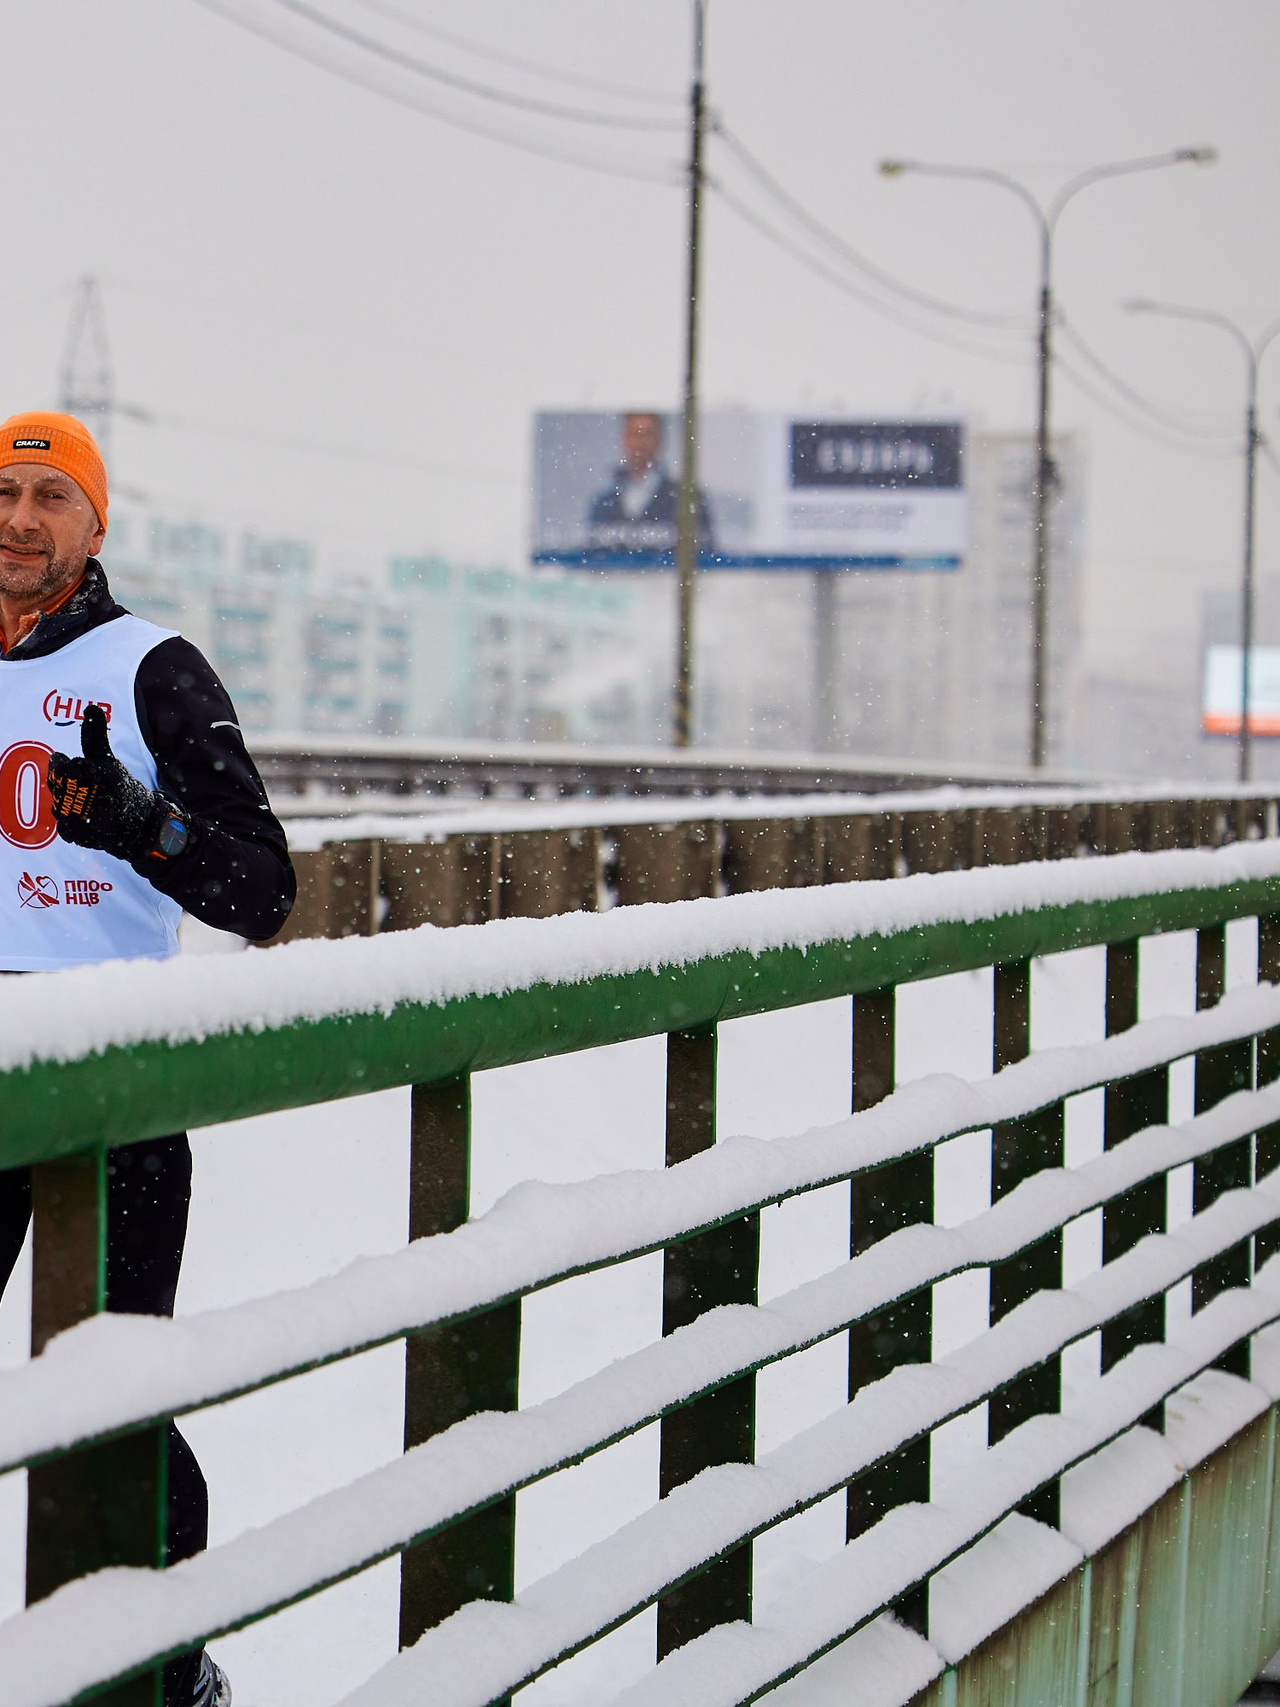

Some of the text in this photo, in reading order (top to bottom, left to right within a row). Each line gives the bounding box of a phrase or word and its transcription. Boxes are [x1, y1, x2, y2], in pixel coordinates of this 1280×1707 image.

[60, 778, 78, 817] MAD FOX
[72, 786, 89, 815] ULTRA
[65, 893, 100, 907] НЦВ
